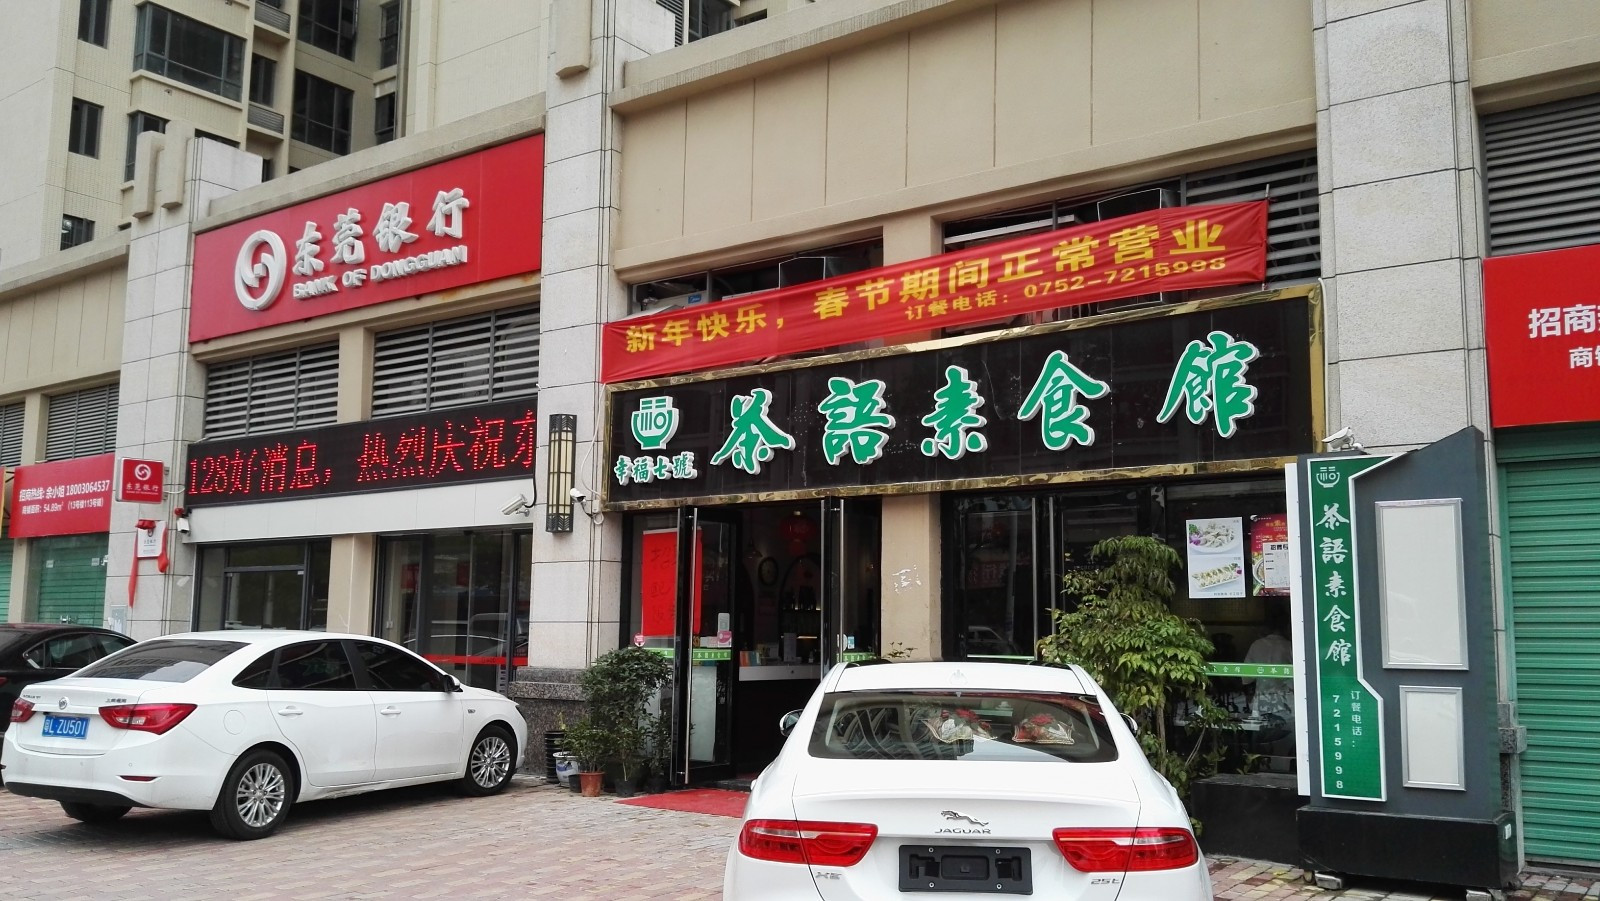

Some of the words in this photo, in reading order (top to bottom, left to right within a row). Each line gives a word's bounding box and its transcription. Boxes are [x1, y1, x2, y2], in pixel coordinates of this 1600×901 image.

[293, 188, 470, 276] 东莞银行
[292, 275, 339, 299] BANK
[342, 269, 368, 287] OF
[371, 245, 468, 281] DONGGUAN
[1528, 304, 1600, 339] 招商
[614, 451, 698, 487] 幸福七號
[1315, 503, 1352, 667] 茶語素食館
[1332, 694, 1344, 789] 7215998
